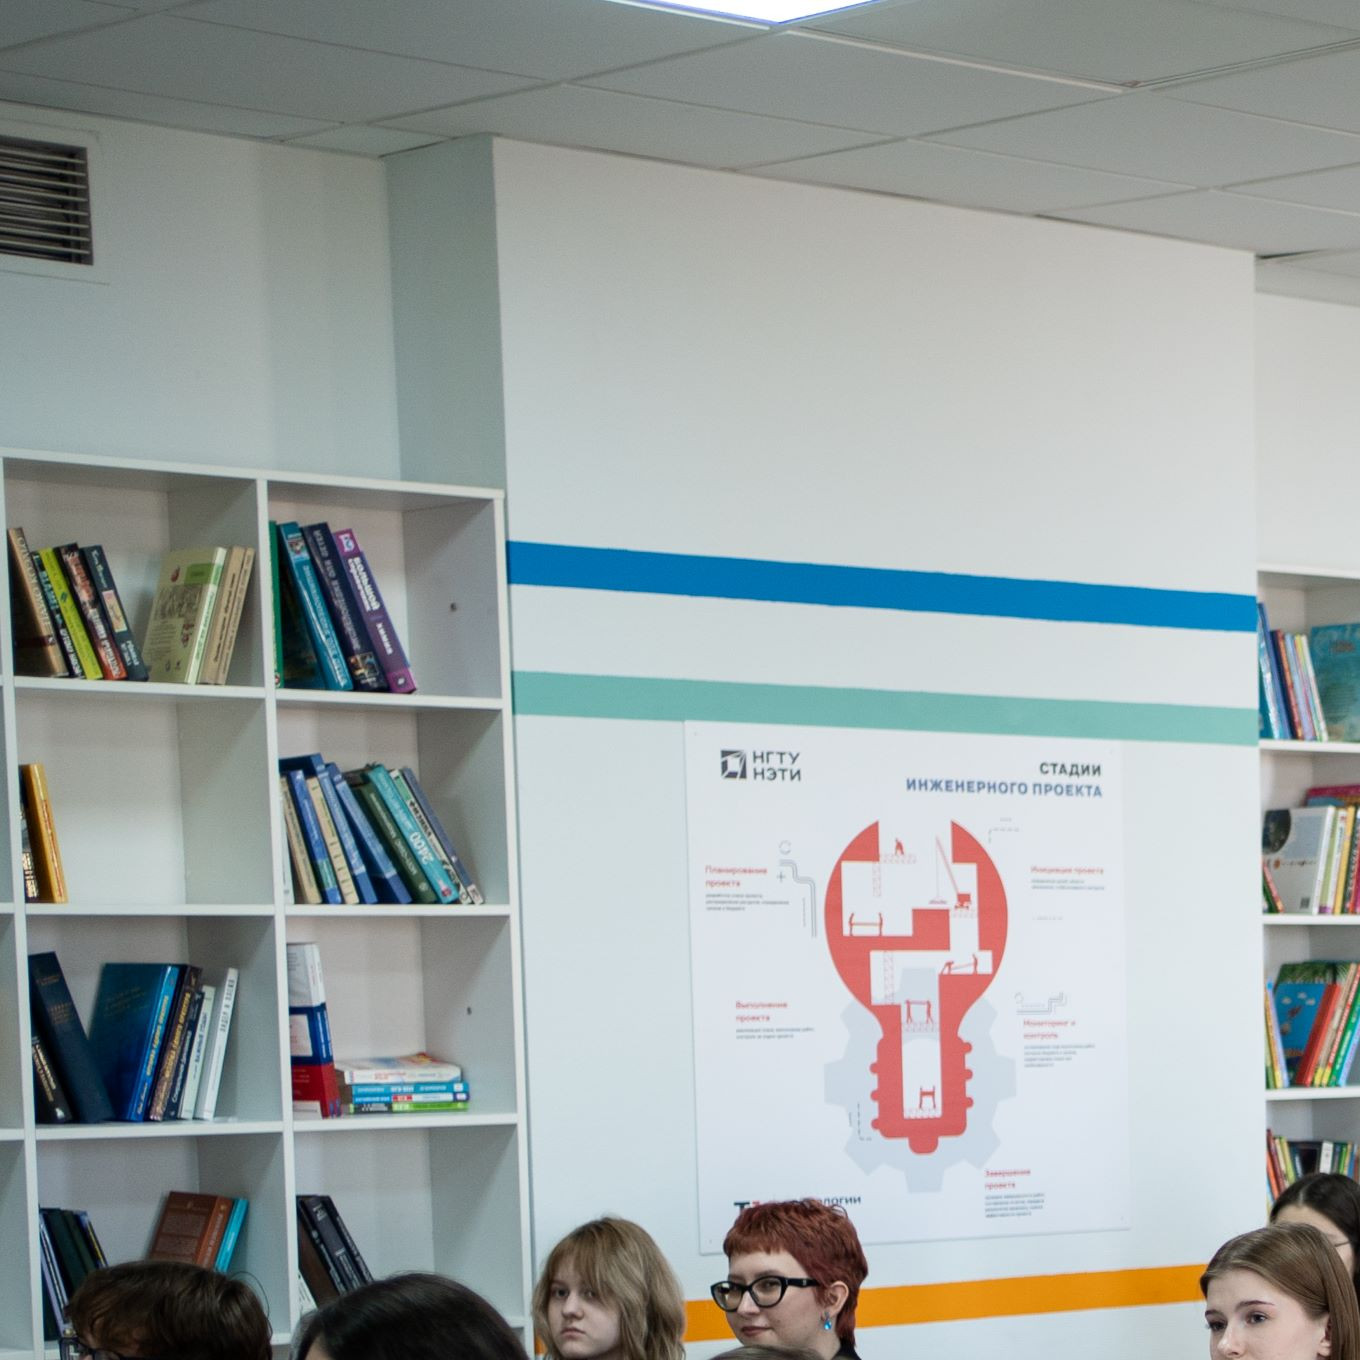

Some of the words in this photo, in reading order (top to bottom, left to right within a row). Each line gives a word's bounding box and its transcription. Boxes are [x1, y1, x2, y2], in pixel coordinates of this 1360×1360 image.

[753, 752, 800, 764] НГТУ
[754, 768, 801, 781] НЭТИ
[1040, 762, 1101, 776] СТАДИИ
[906, 778, 1028, 795] ИНЖЕНЕРНОГО
[1033, 783, 1102, 797] ПРОЕКТА
